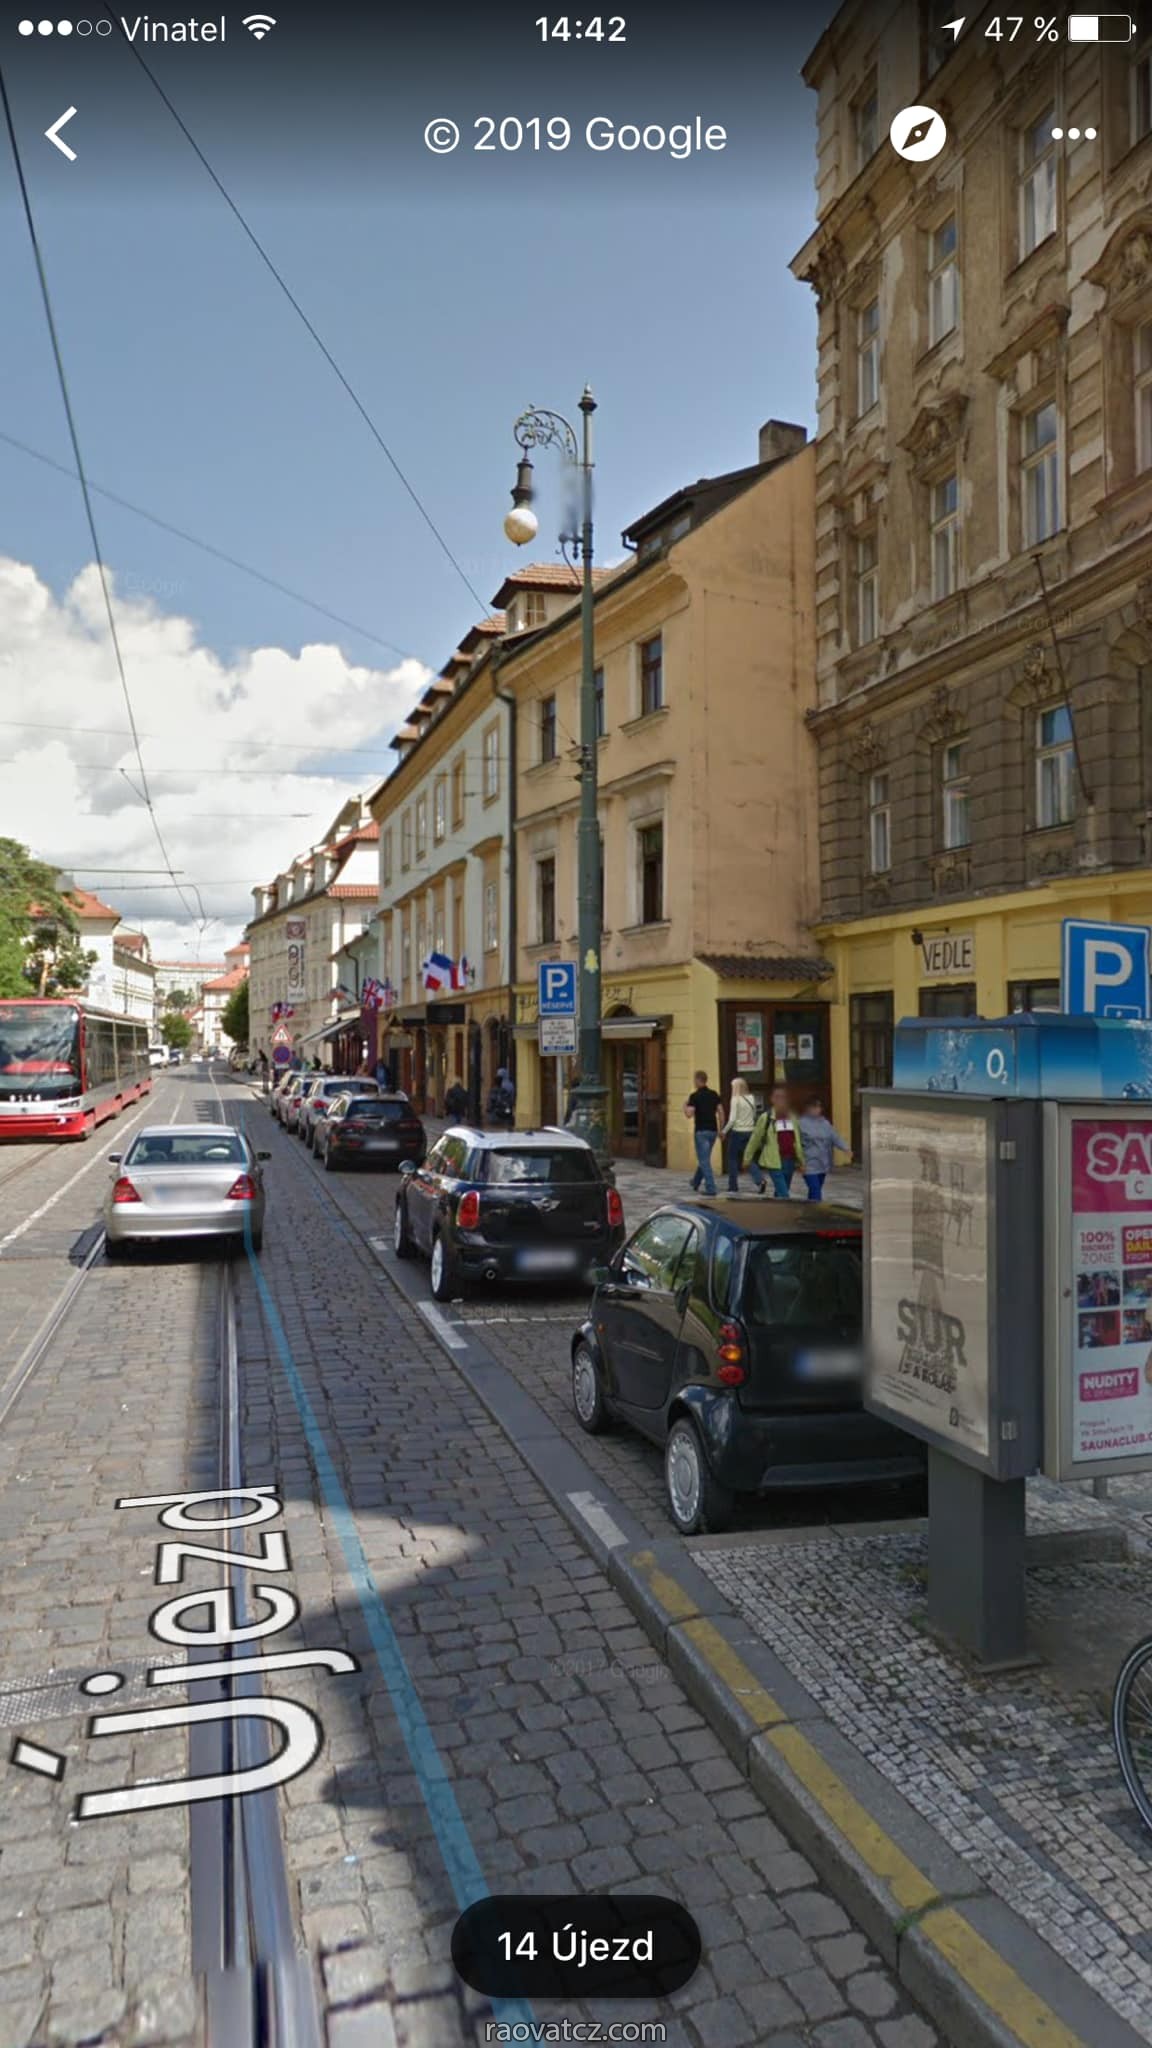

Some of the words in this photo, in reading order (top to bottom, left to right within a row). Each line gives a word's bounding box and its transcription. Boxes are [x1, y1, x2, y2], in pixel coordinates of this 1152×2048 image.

[922, 937, 971, 972] VEDLE
[546, 968, 569, 999] P
[1083, 939, 1133, 1014] P
[1089, 1135, 1152, 1178] SA
[1079, 1231, 1115, 1244] 100%
[1080, 1252, 1115, 1265] ZONE
[897, 1298, 968, 1369] SUR
[1083, 1372, 1135, 1390] NUDITY
